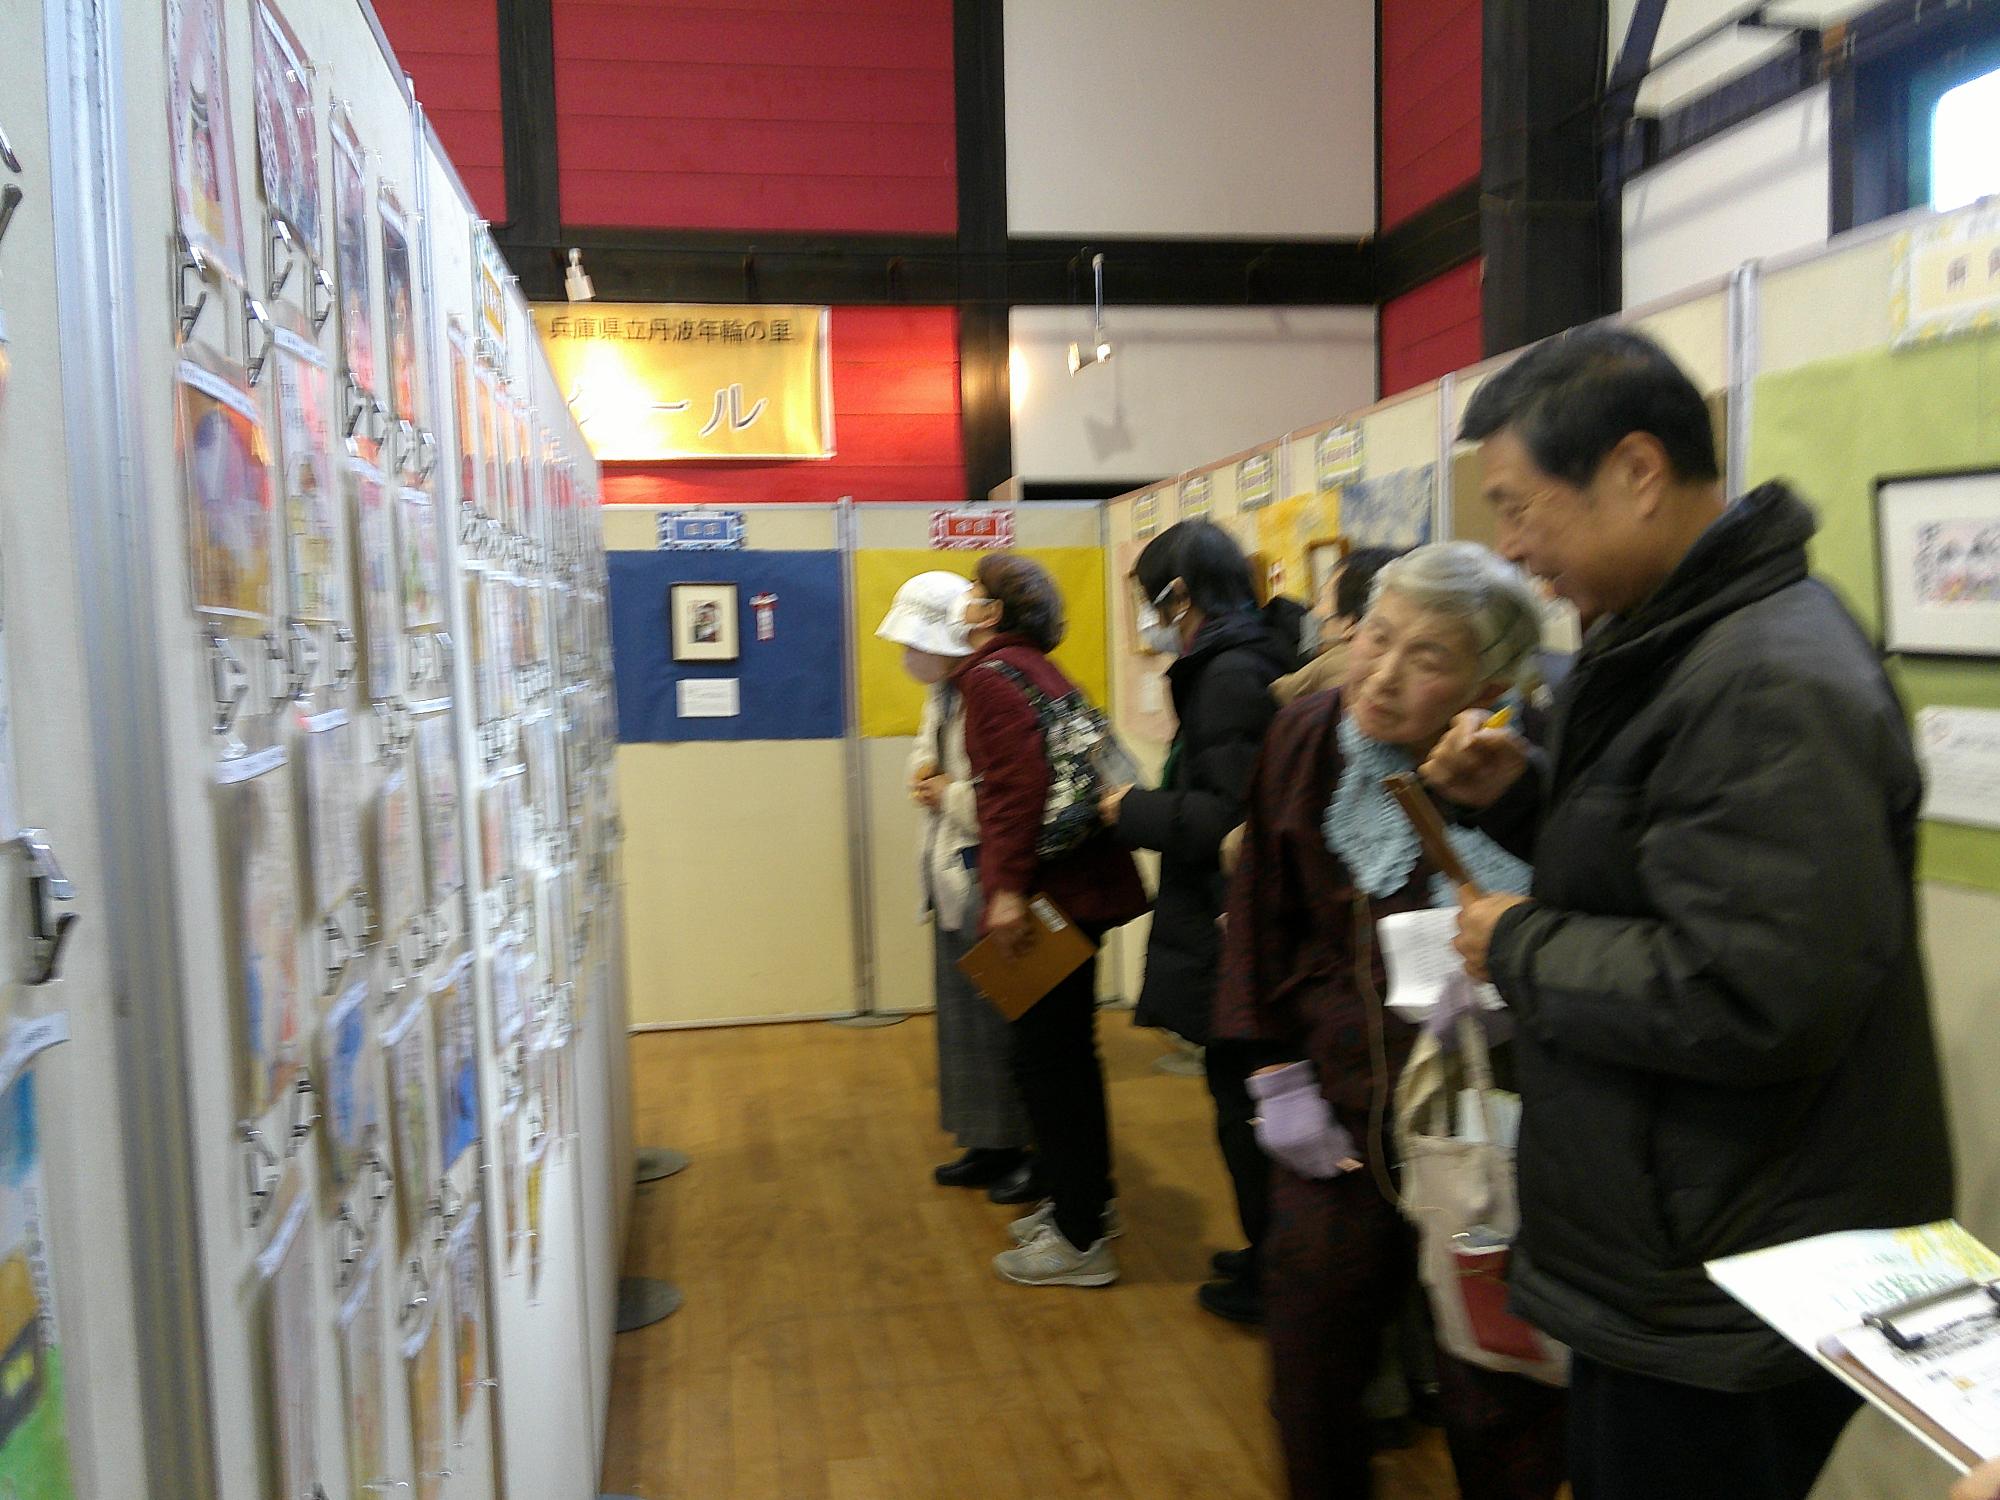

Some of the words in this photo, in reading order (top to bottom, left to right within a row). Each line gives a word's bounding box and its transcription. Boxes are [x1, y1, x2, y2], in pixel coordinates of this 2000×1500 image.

[550, 316, 794, 342] 兵庫県立丹波年輪の里
